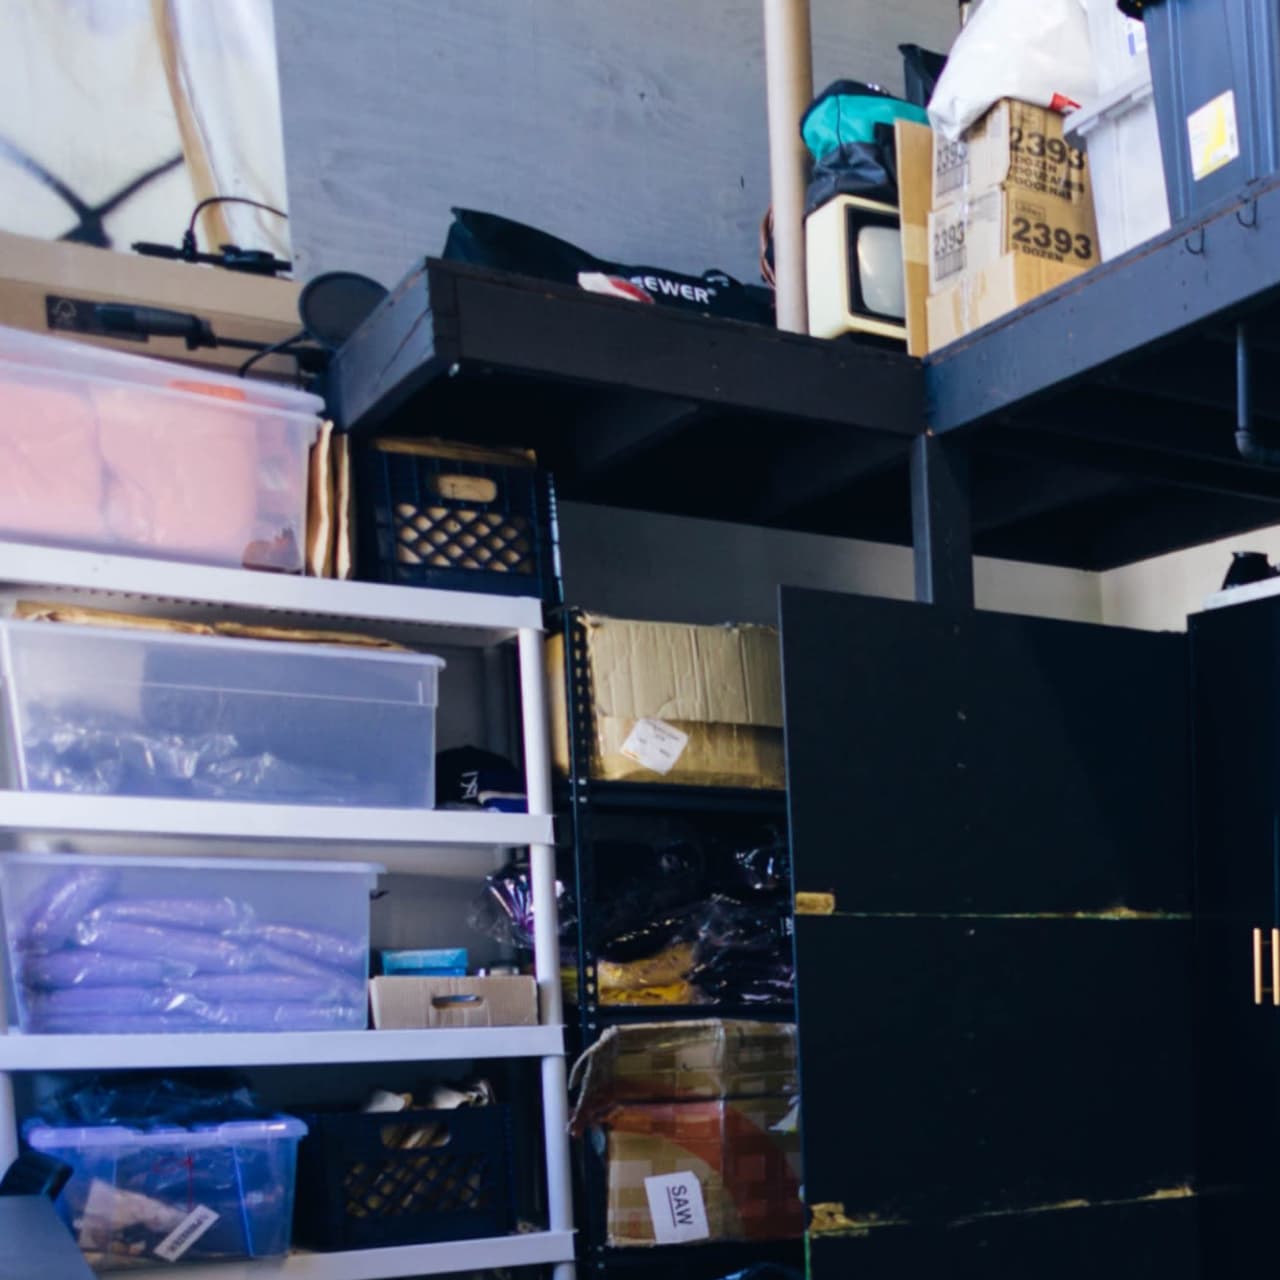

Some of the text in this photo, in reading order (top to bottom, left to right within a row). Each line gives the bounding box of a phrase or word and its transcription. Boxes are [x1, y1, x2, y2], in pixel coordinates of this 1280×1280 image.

[1010, 127, 1084, 170] 2393
[935, 221, 965, 257] 2393
[1012, 217, 1092, 260] 2393
[671, 1184, 694, 1226] SAW
